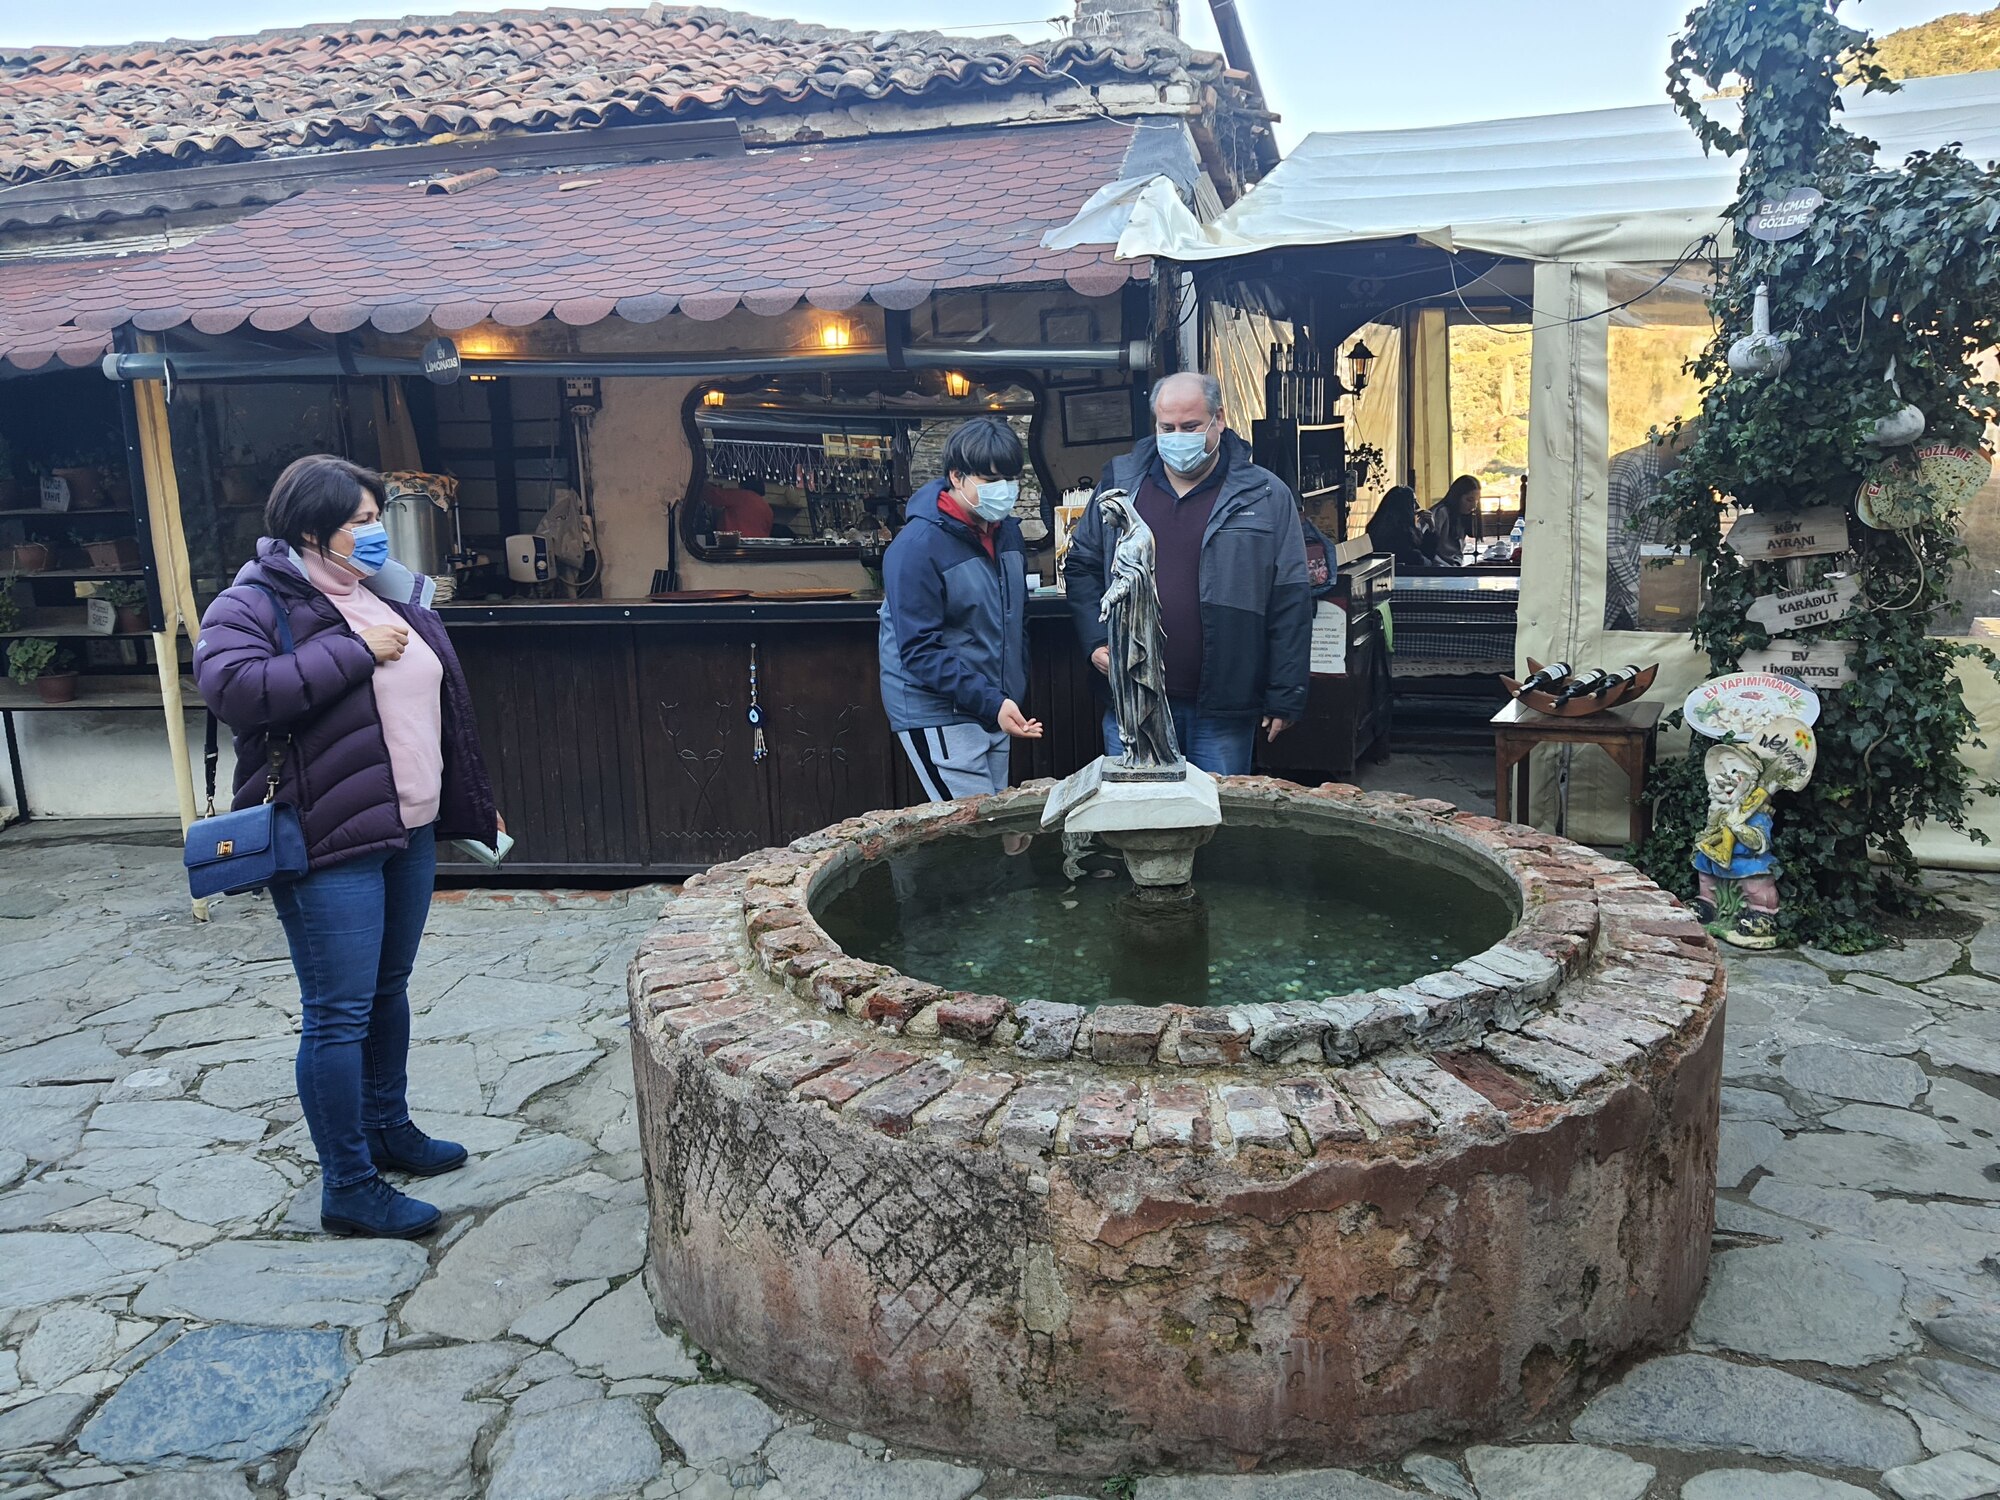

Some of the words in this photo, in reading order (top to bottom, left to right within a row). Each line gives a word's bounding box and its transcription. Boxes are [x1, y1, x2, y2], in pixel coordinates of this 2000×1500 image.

[1760, 203, 1773, 215] EL
[1774, 197, 1816, 214] AÇMASI
[1758, 212, 1808, 229] GÖZLEME
[436, 348, 446, 359] EV
[1773, 521, 1803, 535] KÖY
[1766, 535, 1816, 550] AYRANI
[1777, 592, 1839, 615] KARADUT
[1793, 609, 1830, 626] SUYU
[1791, 651, 1811, 662] EV
[1762, 662, 1840, 677] LİMONATASI
[1703, 685, 1719, 700] EV
[1720, 676, 1761, 691] YAPIMI
[1764, 676, 1803, 700] MANTI
